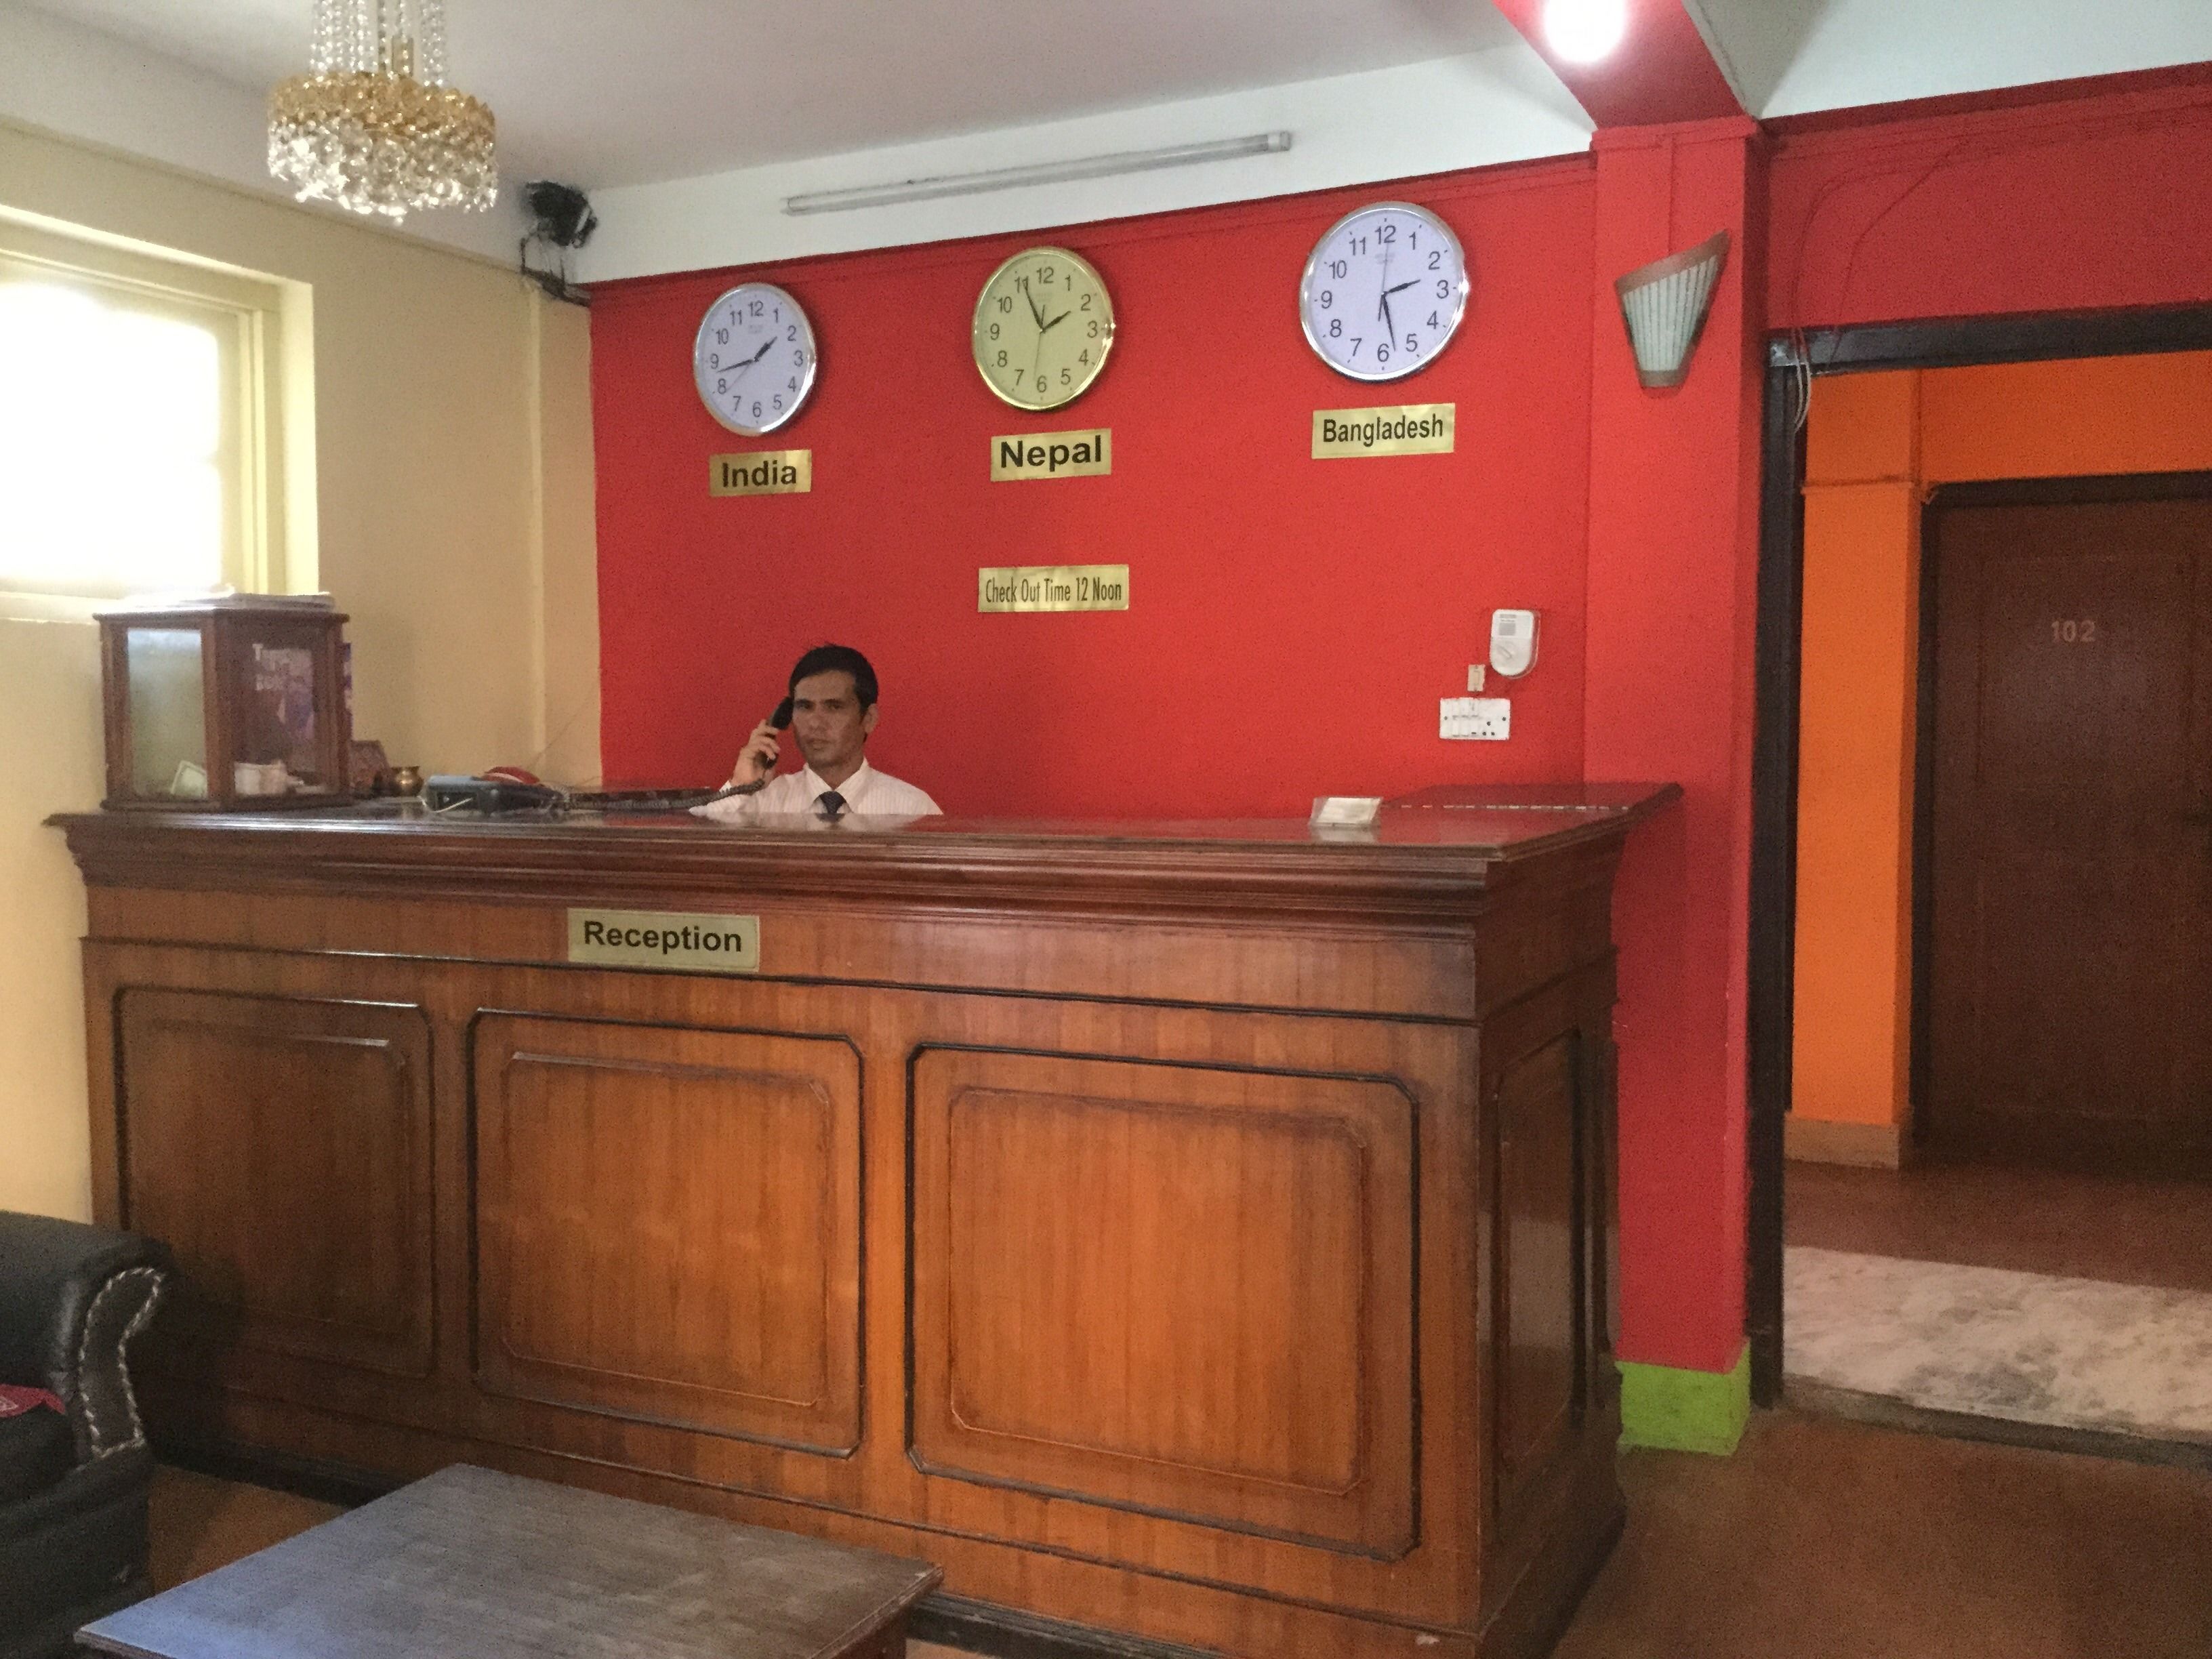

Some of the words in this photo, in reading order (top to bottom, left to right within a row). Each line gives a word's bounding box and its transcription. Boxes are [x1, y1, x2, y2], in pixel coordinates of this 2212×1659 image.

[1374, 226, 1396, 245] 12
[1409, 232, 1415, 250] 1
[1349, 237, 1366, 255] 11
[1429, 251, 1440, 270] 2
[1036, 266, 1054, 284] 12
[1329, 260, 1347, 279] 10
[1015, 276, 1029, 293] 11
[1065, 274, 1071, 291] 1
[1437, 280, 1448, 299] 3
[748, 300, 764, 316] 12
[998, 296, 1012, 313] 10
[1081, 294, 1090, 311] 2
[1321, 291, 1332, 308] 9
[730, 310, 742, 325] 11
[773, 308, 779, 323] 1
[1427, 310, 1438, 329] 4
[716, 328, 729, 344] 10
[787, 325, 796, 342] 2
[990, 323, 1000, 340] 9
[1087, 321, 1097, 337] 3
[1330, 319, 1341, 337] 8
[1350, 338, 1361, 356] 7
[1406, 333, 1417, 352] 5
[710, 354, 719, 369] 9
[794, 350, 803, 367] 3
[998, 350, 1007, 367] 8
[1079, 349, 1088, 365] 4
[1377, 344, 1389, 362] 6
[787, 376, 796, 392] 4
[1015, 369, 1024, 386] 7
[1037, 375, 1046, 392] 6
[1061, 369, 1071, 385] 5
[718, 379, 726, 394] 8
[733, 396, 741, 411] 7
[753, 402, 762, 417] 6
[773, 394, 781, 409] 5
[1324, 413, 1443, 447] Bangladesh
[1001, 435, 1101, 472] Nepal
[722, 460, 796, 487] India
[986, 577, 1017, 602] Check
[1021, 579, 1040, 602] Out
[1044, 579, 1070, 602] Time
[1076, 577, 1088, 600] 12
[1092, 577, 1121, 600] Noon
[2051, 620, 2095, 642] 102
[584, 921, 741, 954] Reception
